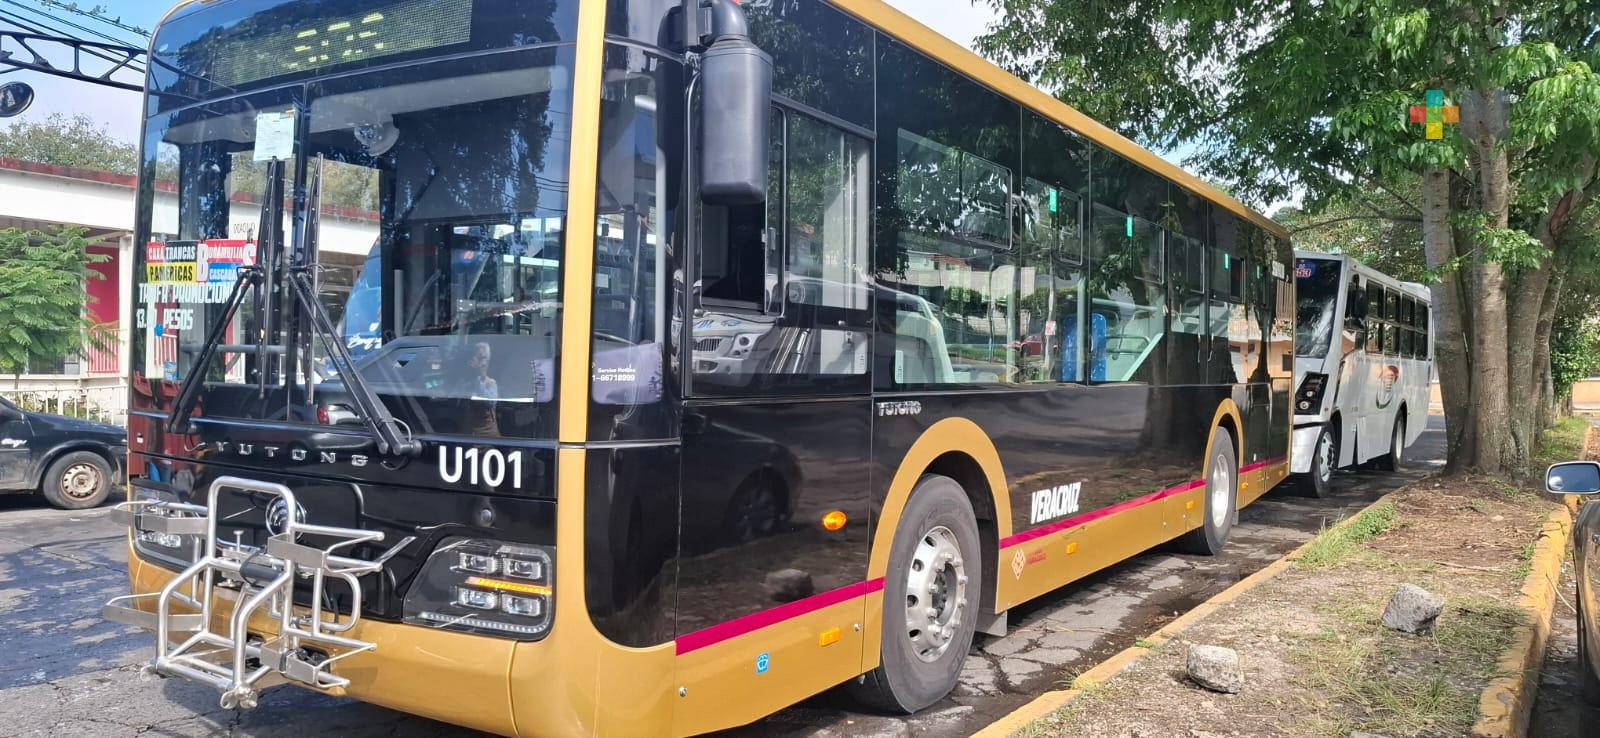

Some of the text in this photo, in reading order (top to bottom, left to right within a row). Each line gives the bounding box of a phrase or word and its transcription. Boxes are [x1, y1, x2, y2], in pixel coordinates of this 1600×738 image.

[165, 245, 196, 261] TRANCAS
[163, 308, 194, 330] PESOS
[874, 400, 922, 417] YUTONG
[215, 441, 369, 467] YUTONG
[438, 445, 523, 489] U101
[1030, 481, 1082, 525] VERACRUZ
